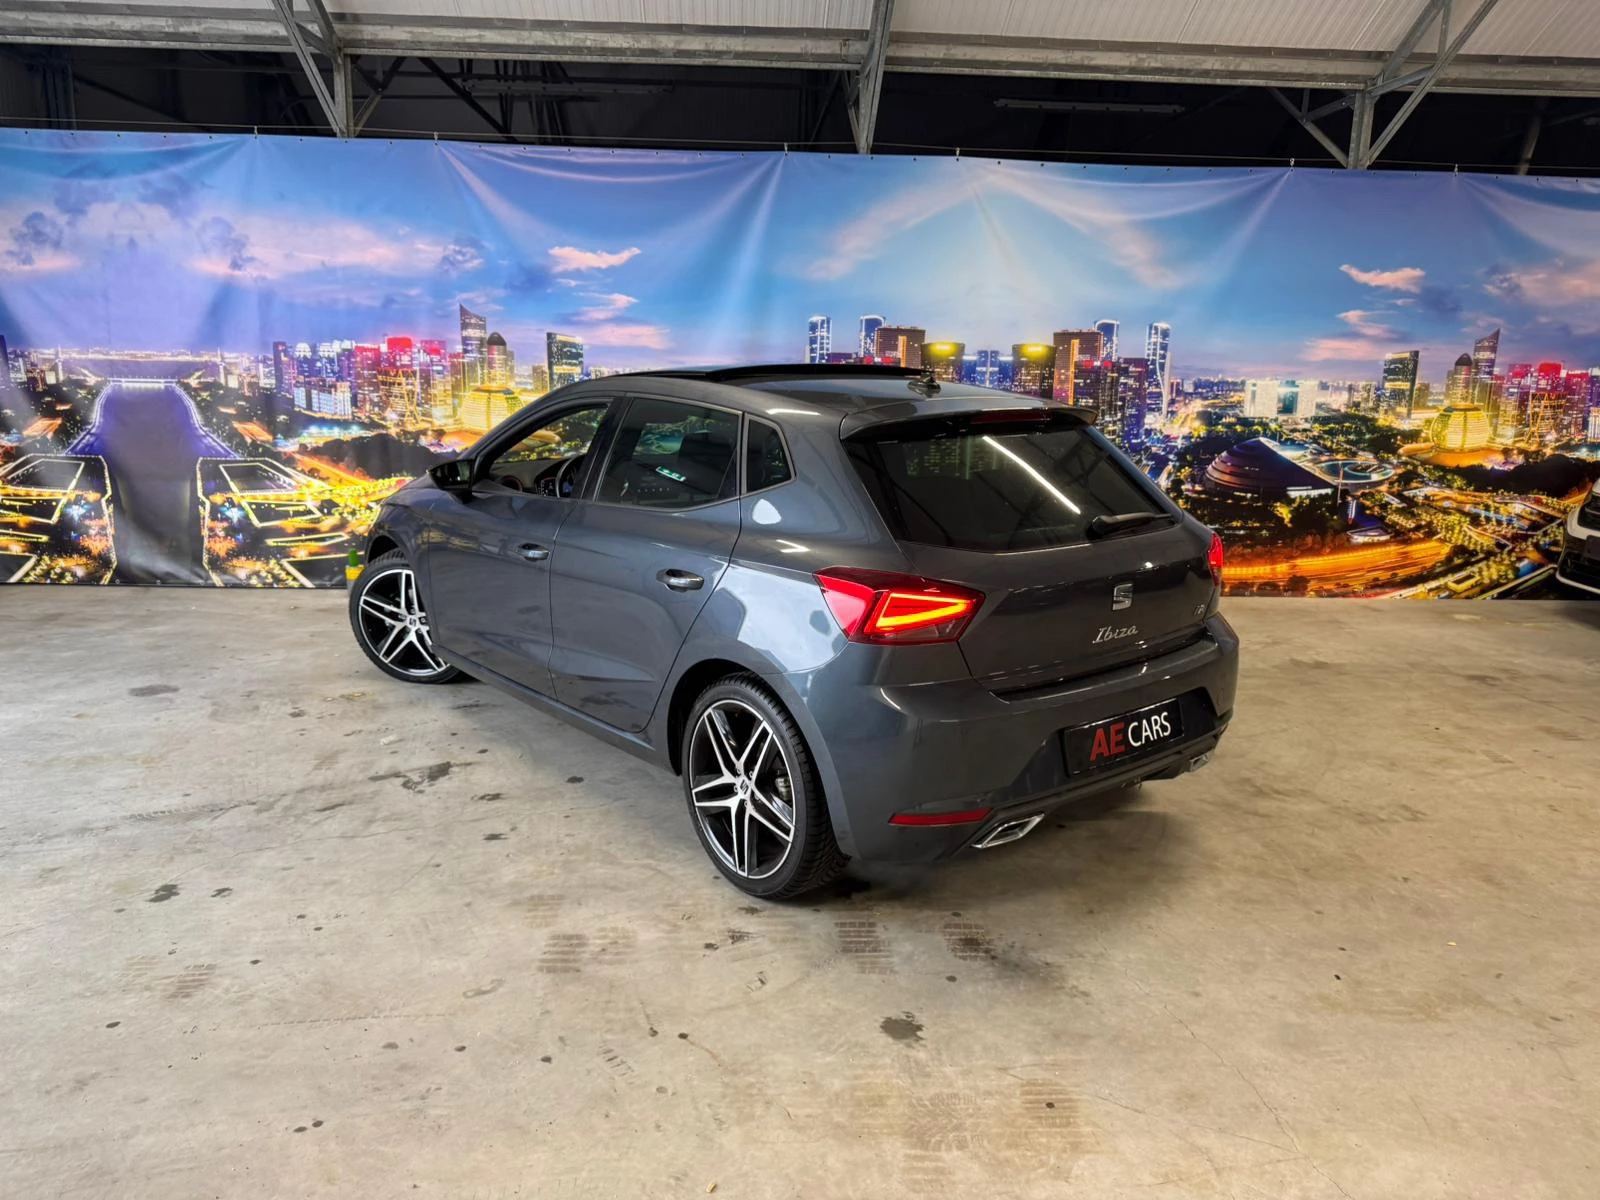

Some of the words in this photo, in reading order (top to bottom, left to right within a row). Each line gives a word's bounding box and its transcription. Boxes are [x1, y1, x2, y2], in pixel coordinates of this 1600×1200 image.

[1092, 625, 1138, 643] Ibiza
[1089, 721, 1126, 761] AE
[1127, 711, 1171, 747] CARS
